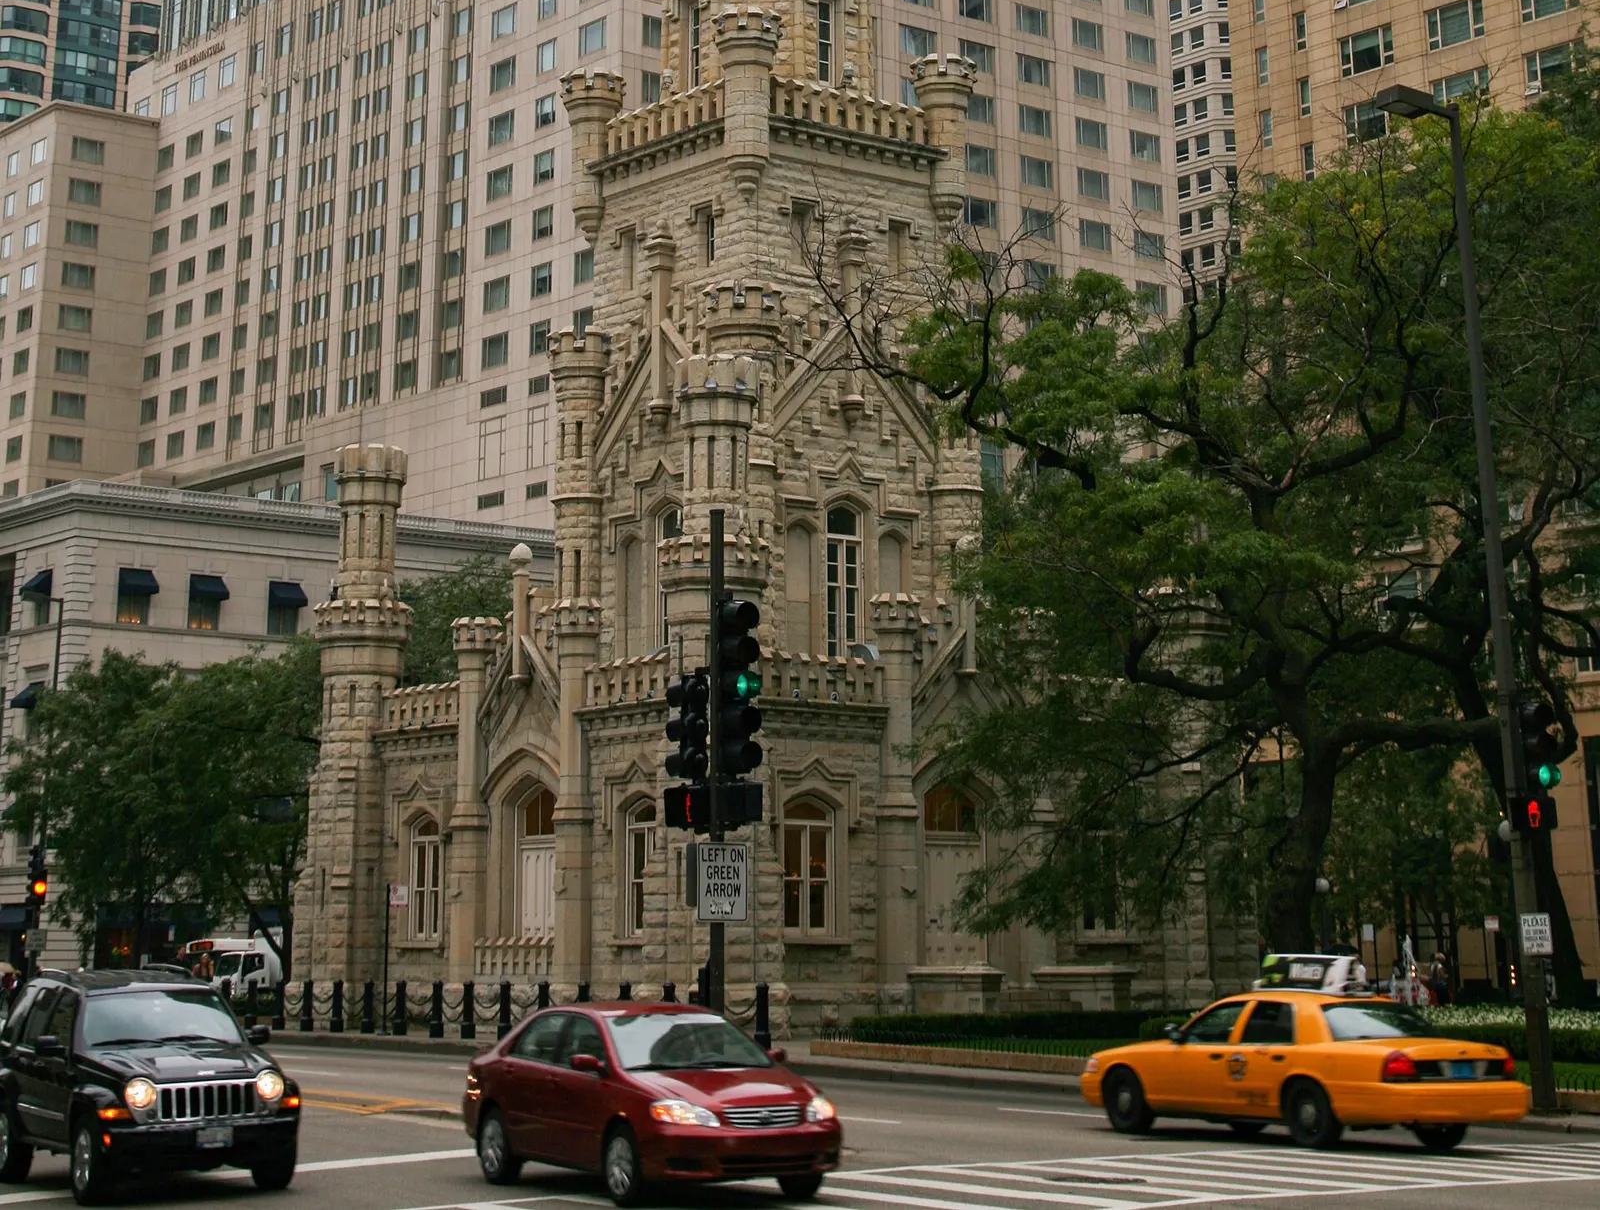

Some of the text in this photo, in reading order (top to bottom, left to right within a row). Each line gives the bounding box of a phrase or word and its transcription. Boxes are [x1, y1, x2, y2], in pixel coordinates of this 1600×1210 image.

[174, 40, 226, 74] THE PENINSULA
[701, 847, 744, 863] LEFT ON
[706, 865, 740, 880] GREEN
[705, 883, 742, 898] ARROW
[1522, 917, 1548, 927] PLEASE
